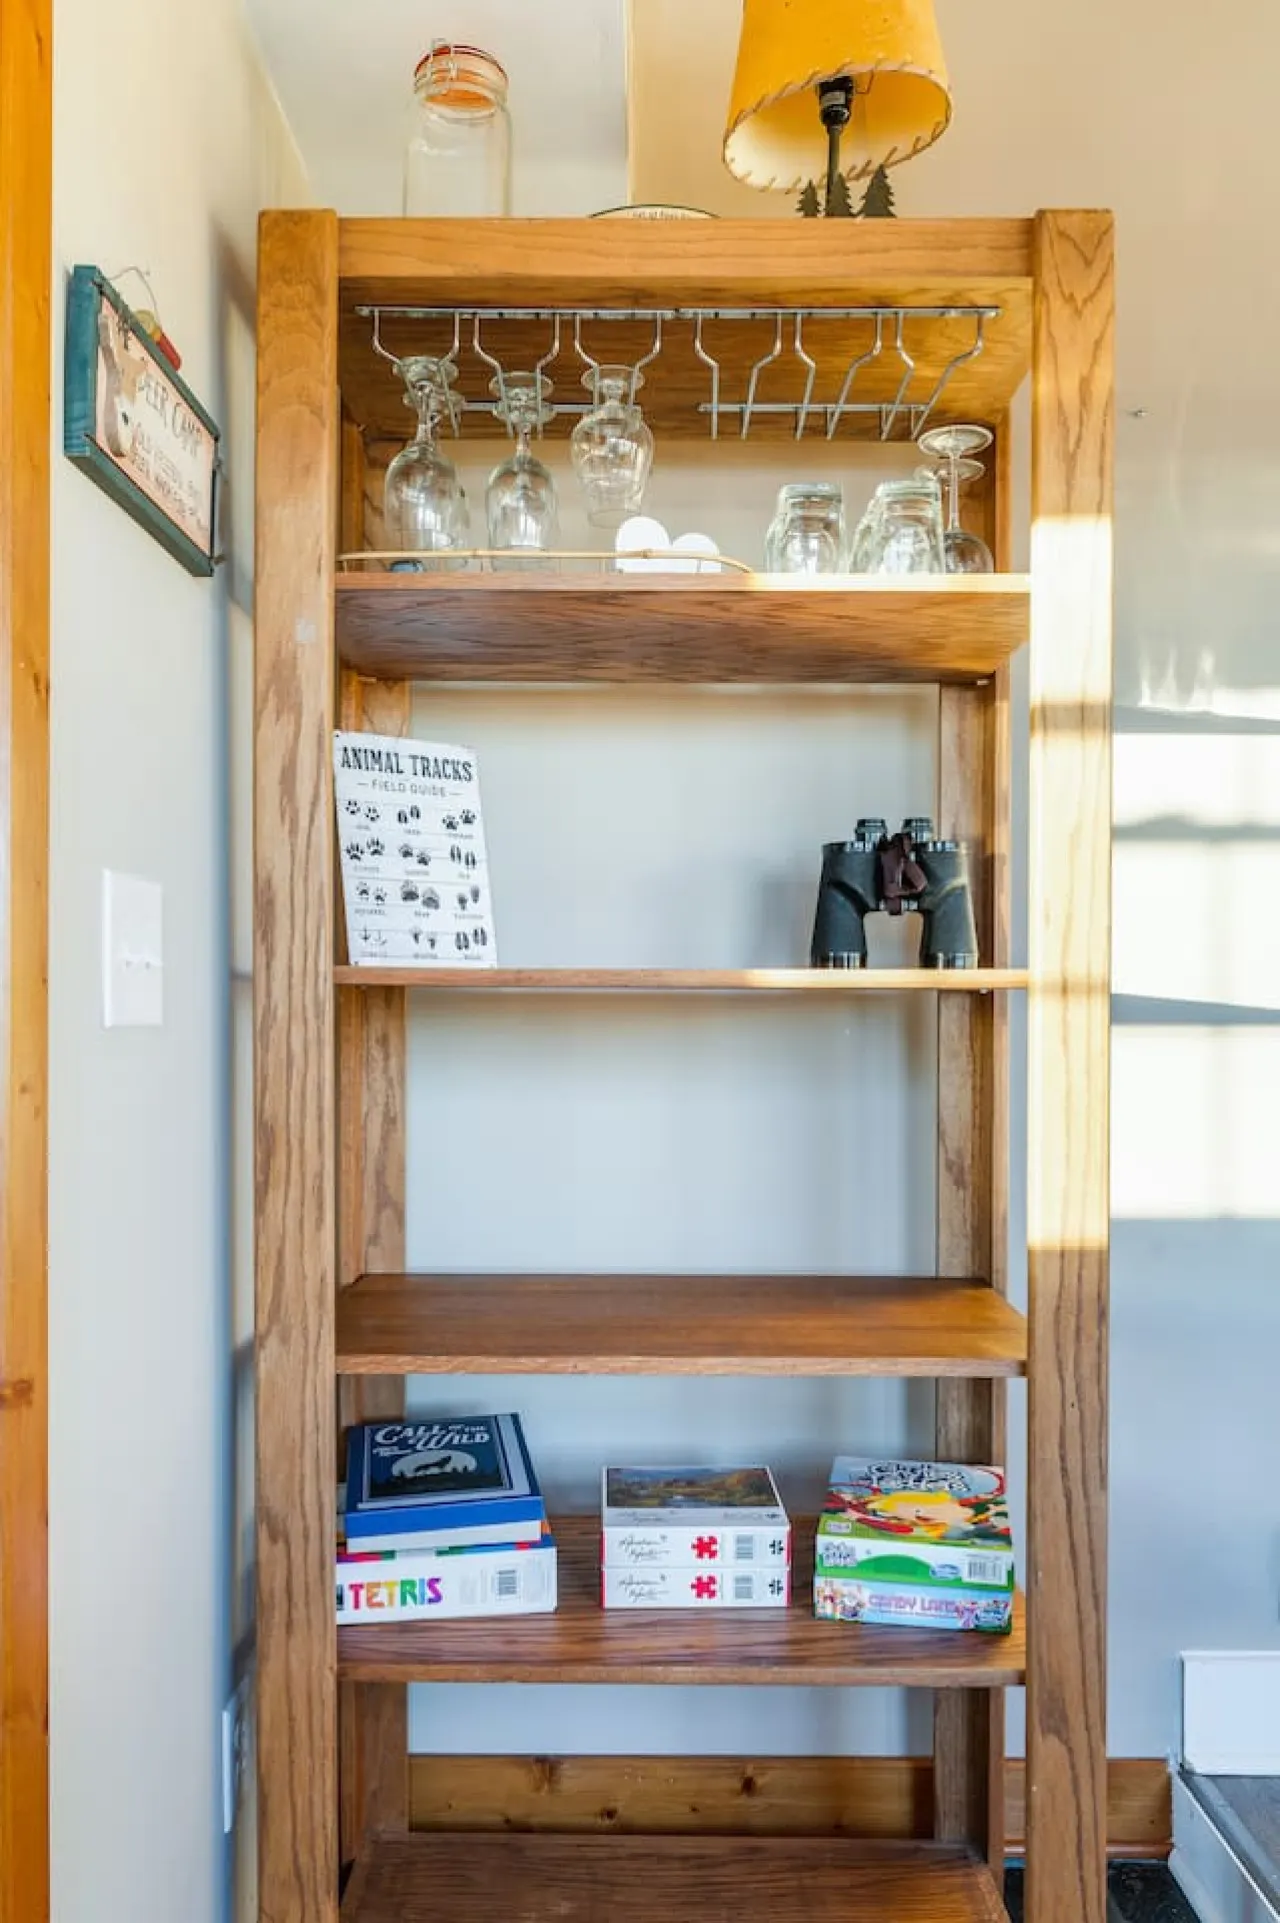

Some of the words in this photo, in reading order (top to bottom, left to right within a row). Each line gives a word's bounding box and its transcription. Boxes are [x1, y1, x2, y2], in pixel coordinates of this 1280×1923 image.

[341, 745, 404, 774] ANIMAL
[408, 754, 473, 783] TRACKS
[371, 778, 406, 792] FIELD
[410, 782, 446, 797] GUIDE
[374, 1425, 447, 1445] CALL
[415, 1432, 490, 1451] WILD
[348, 1577, 443, 1611] TETRIS
